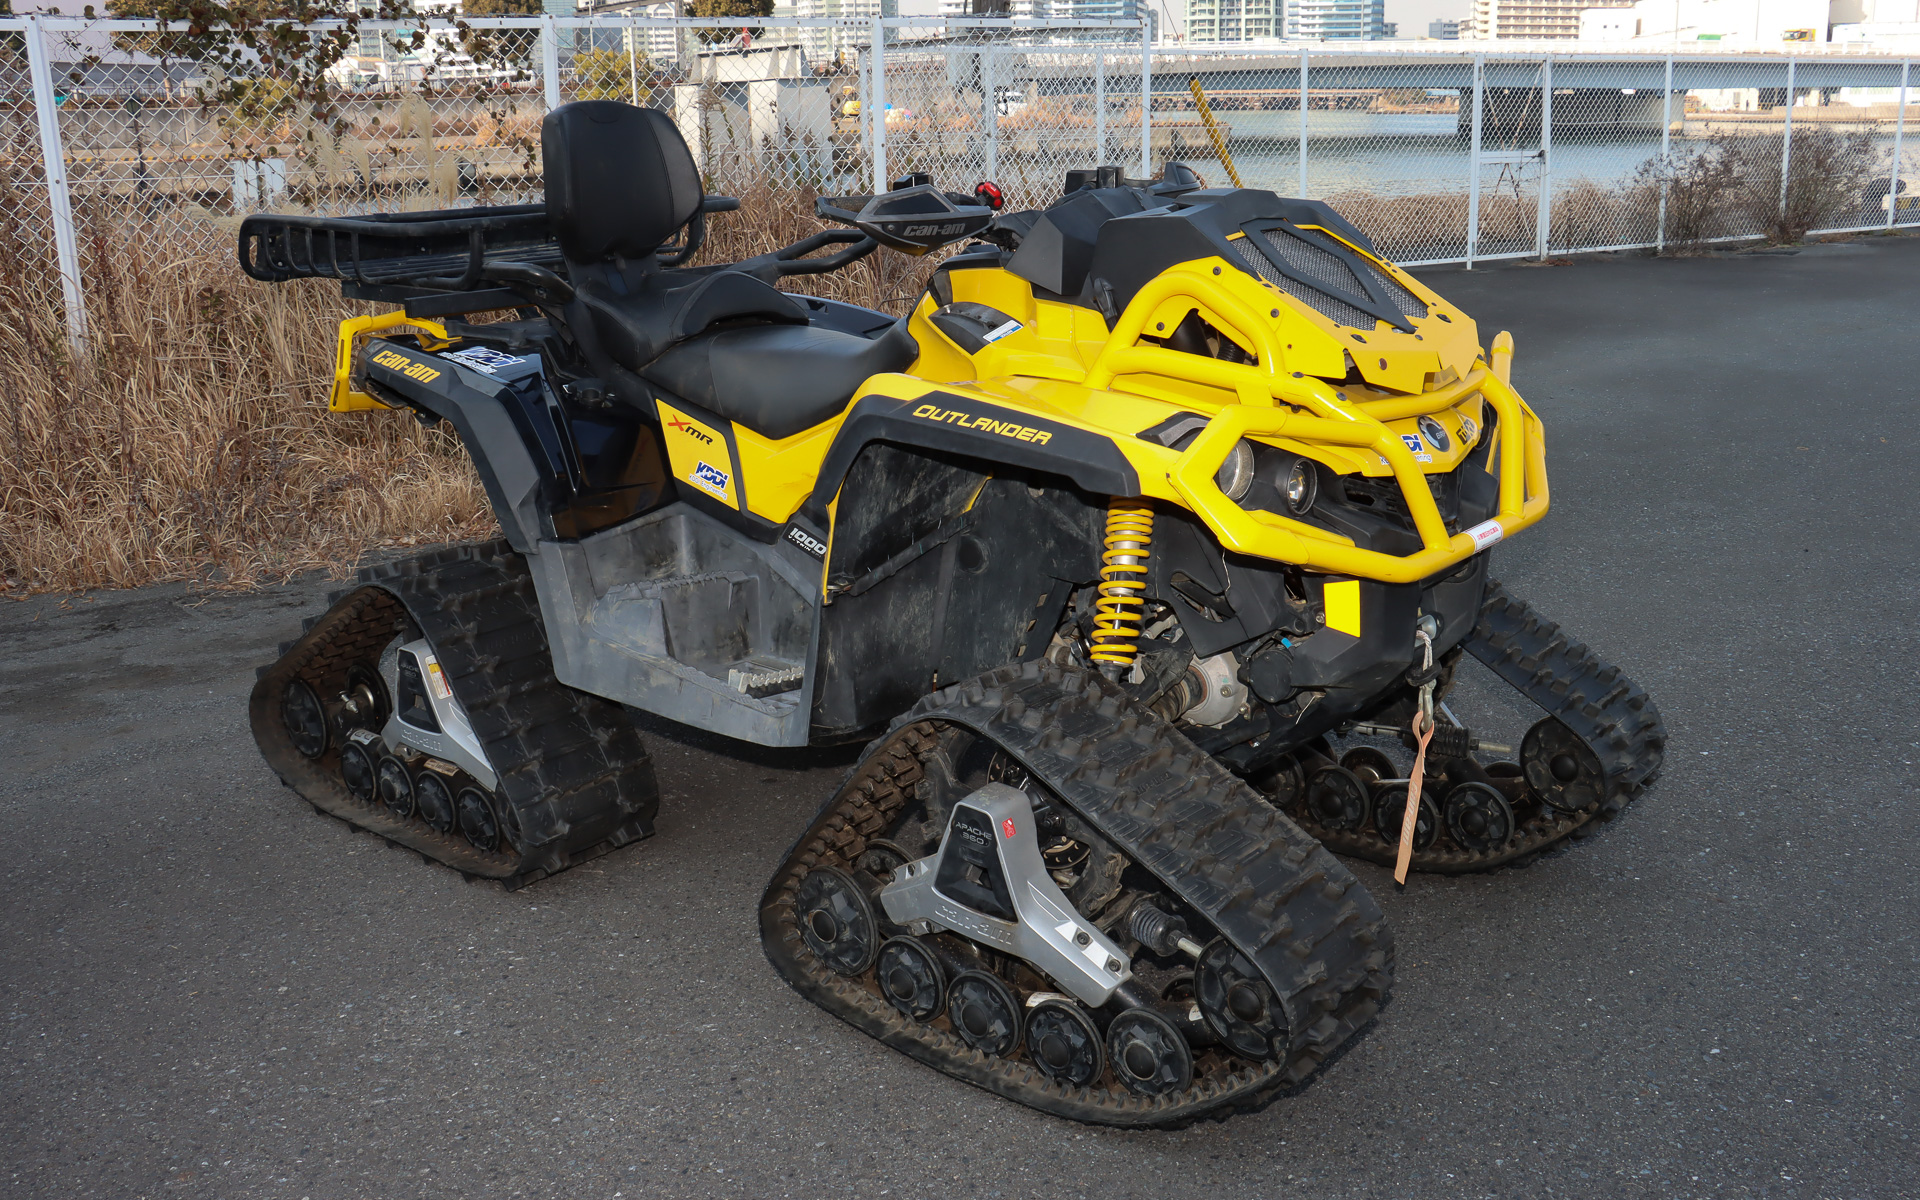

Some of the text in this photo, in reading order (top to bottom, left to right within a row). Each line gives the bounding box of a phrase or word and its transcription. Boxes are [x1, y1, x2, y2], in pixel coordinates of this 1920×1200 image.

[903, 223, 966, 237] can-am
[372, 350, 441, 384] can-am
[912, 404, 1053, 445] OUTLANDER
[695, 461, 729, 489] KDDI
[701, 480, 728, 500] Engineering
[788, 535, 811, 551] V-TWIN
[789, 527, 827, 555] 1000
[955, 821, 993, 840] APACHE
[961, 831, 985, 845] 360
[934, 903, 1015, 946] can-am
